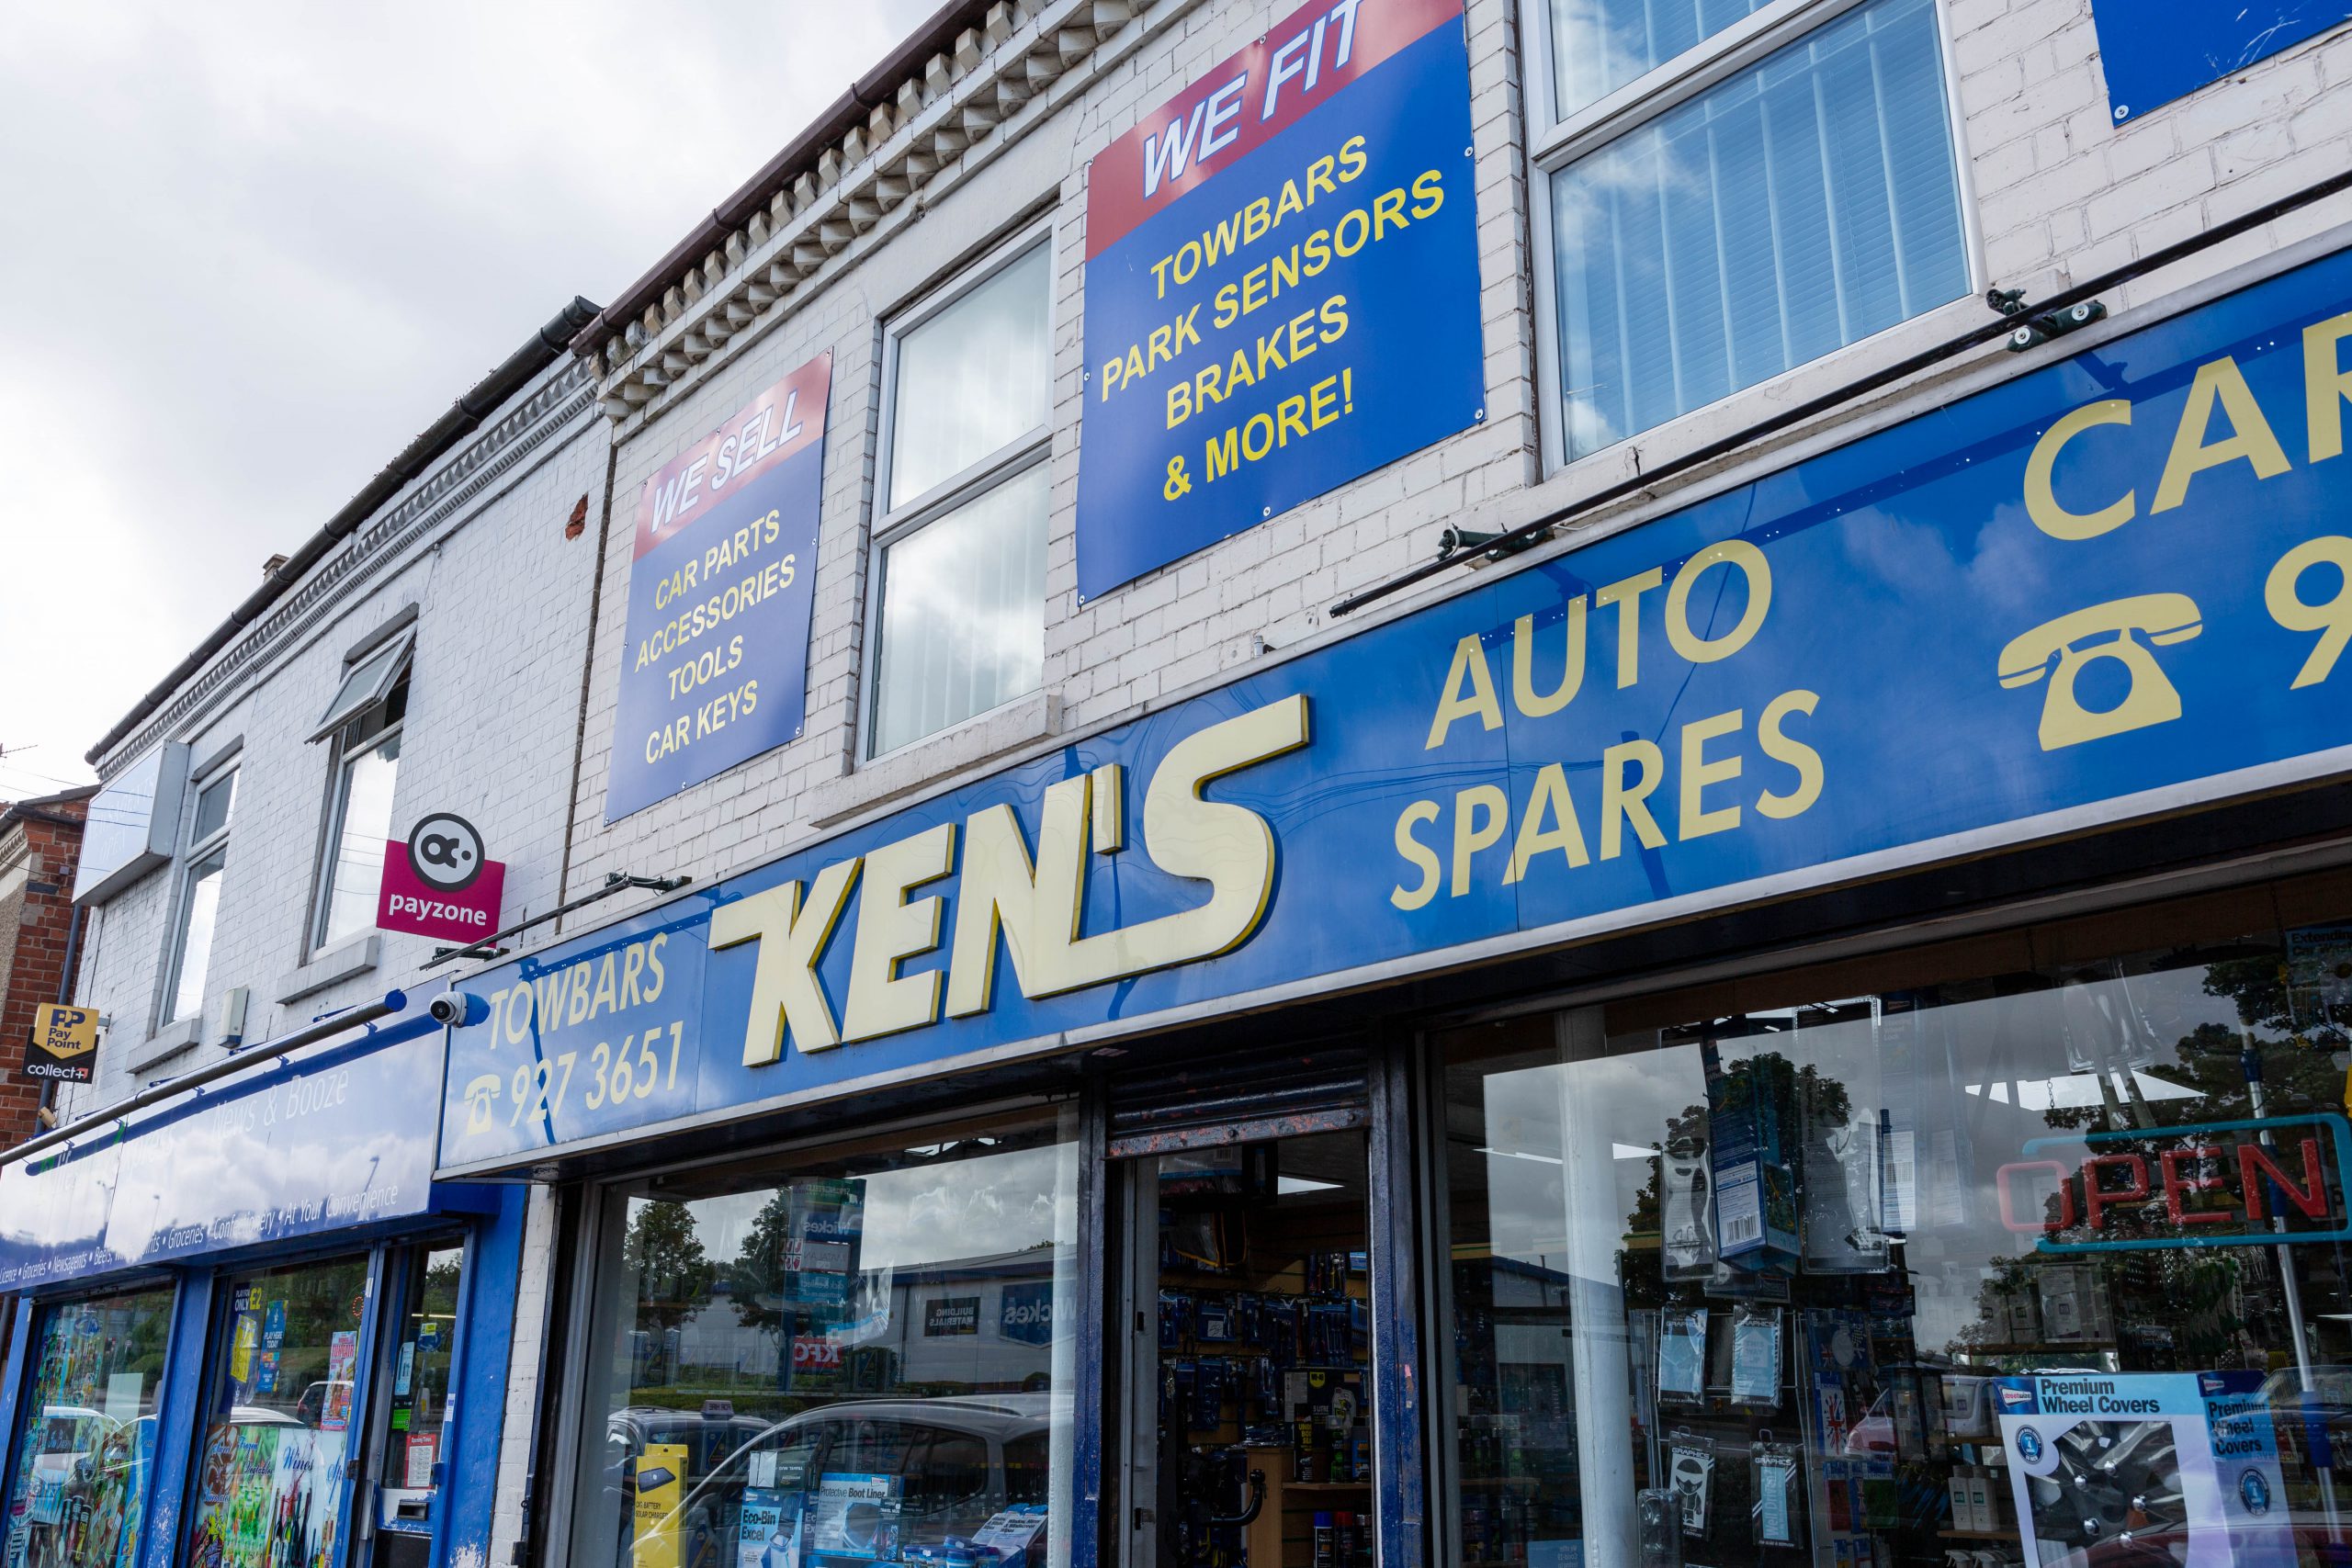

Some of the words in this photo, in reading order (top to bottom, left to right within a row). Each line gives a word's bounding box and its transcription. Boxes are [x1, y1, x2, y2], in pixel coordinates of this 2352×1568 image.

[1143, 73, 1247, 199] WE
[1261, 0, 1363, 122] FIT
[1150, 135, 1367, 299] TOWBARS
[1102, 303, 1202, 402] PARK
[1214, 169, 1445, 329] SENSORS
[1167, 294, 1350, 430] BRAKES
[650, 454, 708, 534] WE
[711, 390, 802, 491] SELL
[1163, 455, 1192, 501] &
[1206, 367, 1353, 482] MORE!
[655, 560, 695, 611] CAR
[704, 509, 780, 581] PARTS
[635, 554, 797, 672] ACCESSORIES
[1424, 539, 1772, 751] AUTO
[669, 635, 743, 702] TOOLS
[646, 719, 689, 764] CAR
[696, 680, 758, 740] KEYS
[1389, 689, 1825, 911] SPARES
[389, 891, 488, 926] payzone
[708, 694, 1309, 1067] KEN'S
[491, 931, 668, 1050] TOWBARS
[47, 1035, 82, 1051] Point
[48, 1027, 72, 1043] Pay
[213, 1099, 257, 1141] News
[264, 1086, 277, 1125] &
[286, 1069, 349, 1121] Booze
[509, 1051, 577, 1128] 927
[585, 1021, 684, 1111] 3651
[1996, 1137, 2328, 1233] OPEN
[22, 1260, 47, 1280] Groceries
[52, 1251, 87, 1275] Newsagents
[168, 1223, 205, 1249] Groceries
[213, 1210, 276, 1240] Confectionery
[285, 1204, 298, 1225] At
[300, 1198, 323, 1223] Your
[326, 1184, 399, 1218] Convenience
[235, 1298, 250, 1312] ONLY
[250, 1287, 263, 1310] £2
[2041, 1378, 2115, 1394] Premium
[2041, 1395, 2094, 1413] Wheel
[2098, 1395, 2161, 1413] Covers
[2208, 1400, 2266, 1418] Premium
[283, 1447, 314, 1471] Wines
[1671, 1446, 1711, 1459] GRAPHICS
[1755, 1457, 1792, 1465] GRAPHICS
[2215, 1438, 2263, 1456] Covers
[643, 1502, 662, 1510] BATTERY
[742, 1509, 776, 1526] Eco-Bin
[820, 1485, 848, 1497] Protective
[849, 1487, 865, 1498] Boot
[866, 1488, 886, 1498] Liner
[1764, 1513, 1779, 1536] Well
[741, 1525, 765, 1541] Excel
